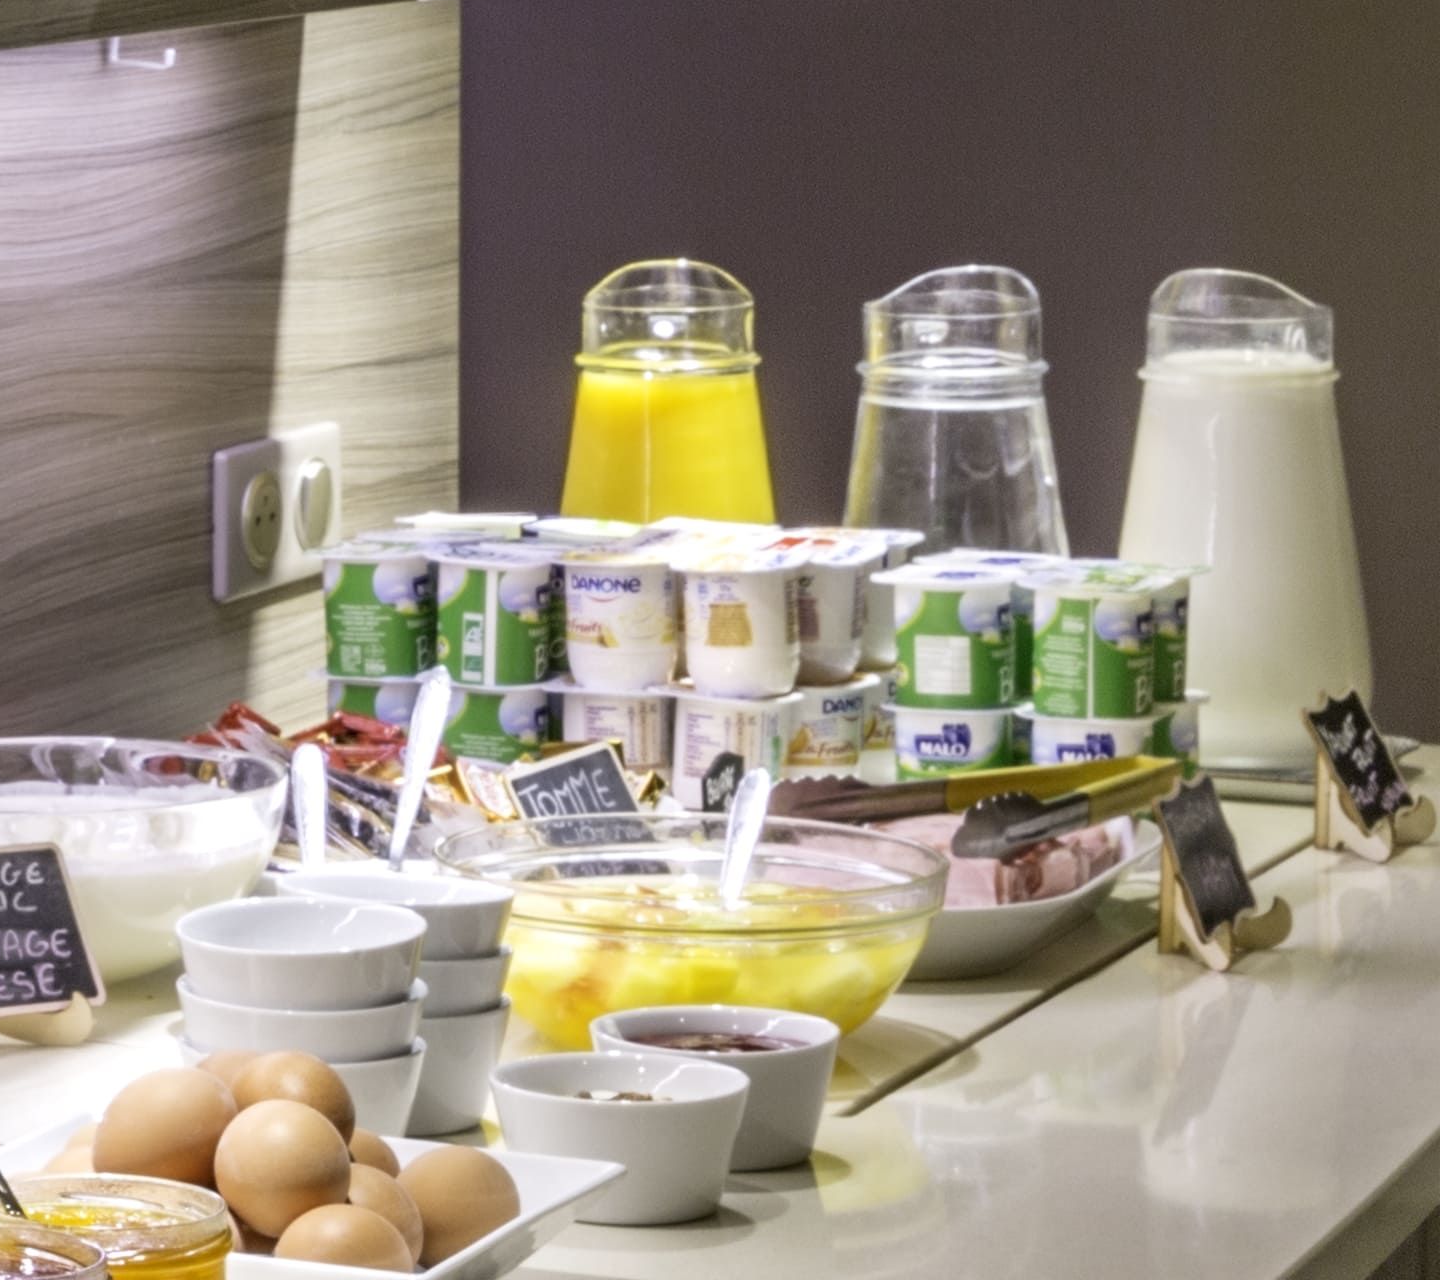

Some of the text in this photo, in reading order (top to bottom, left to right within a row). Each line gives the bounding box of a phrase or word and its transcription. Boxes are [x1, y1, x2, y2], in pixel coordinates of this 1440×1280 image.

[822, 696, 864, 715] DAN
[918, 741, 967, 756] MALO
[517, 768, 617, 818] TOMME
